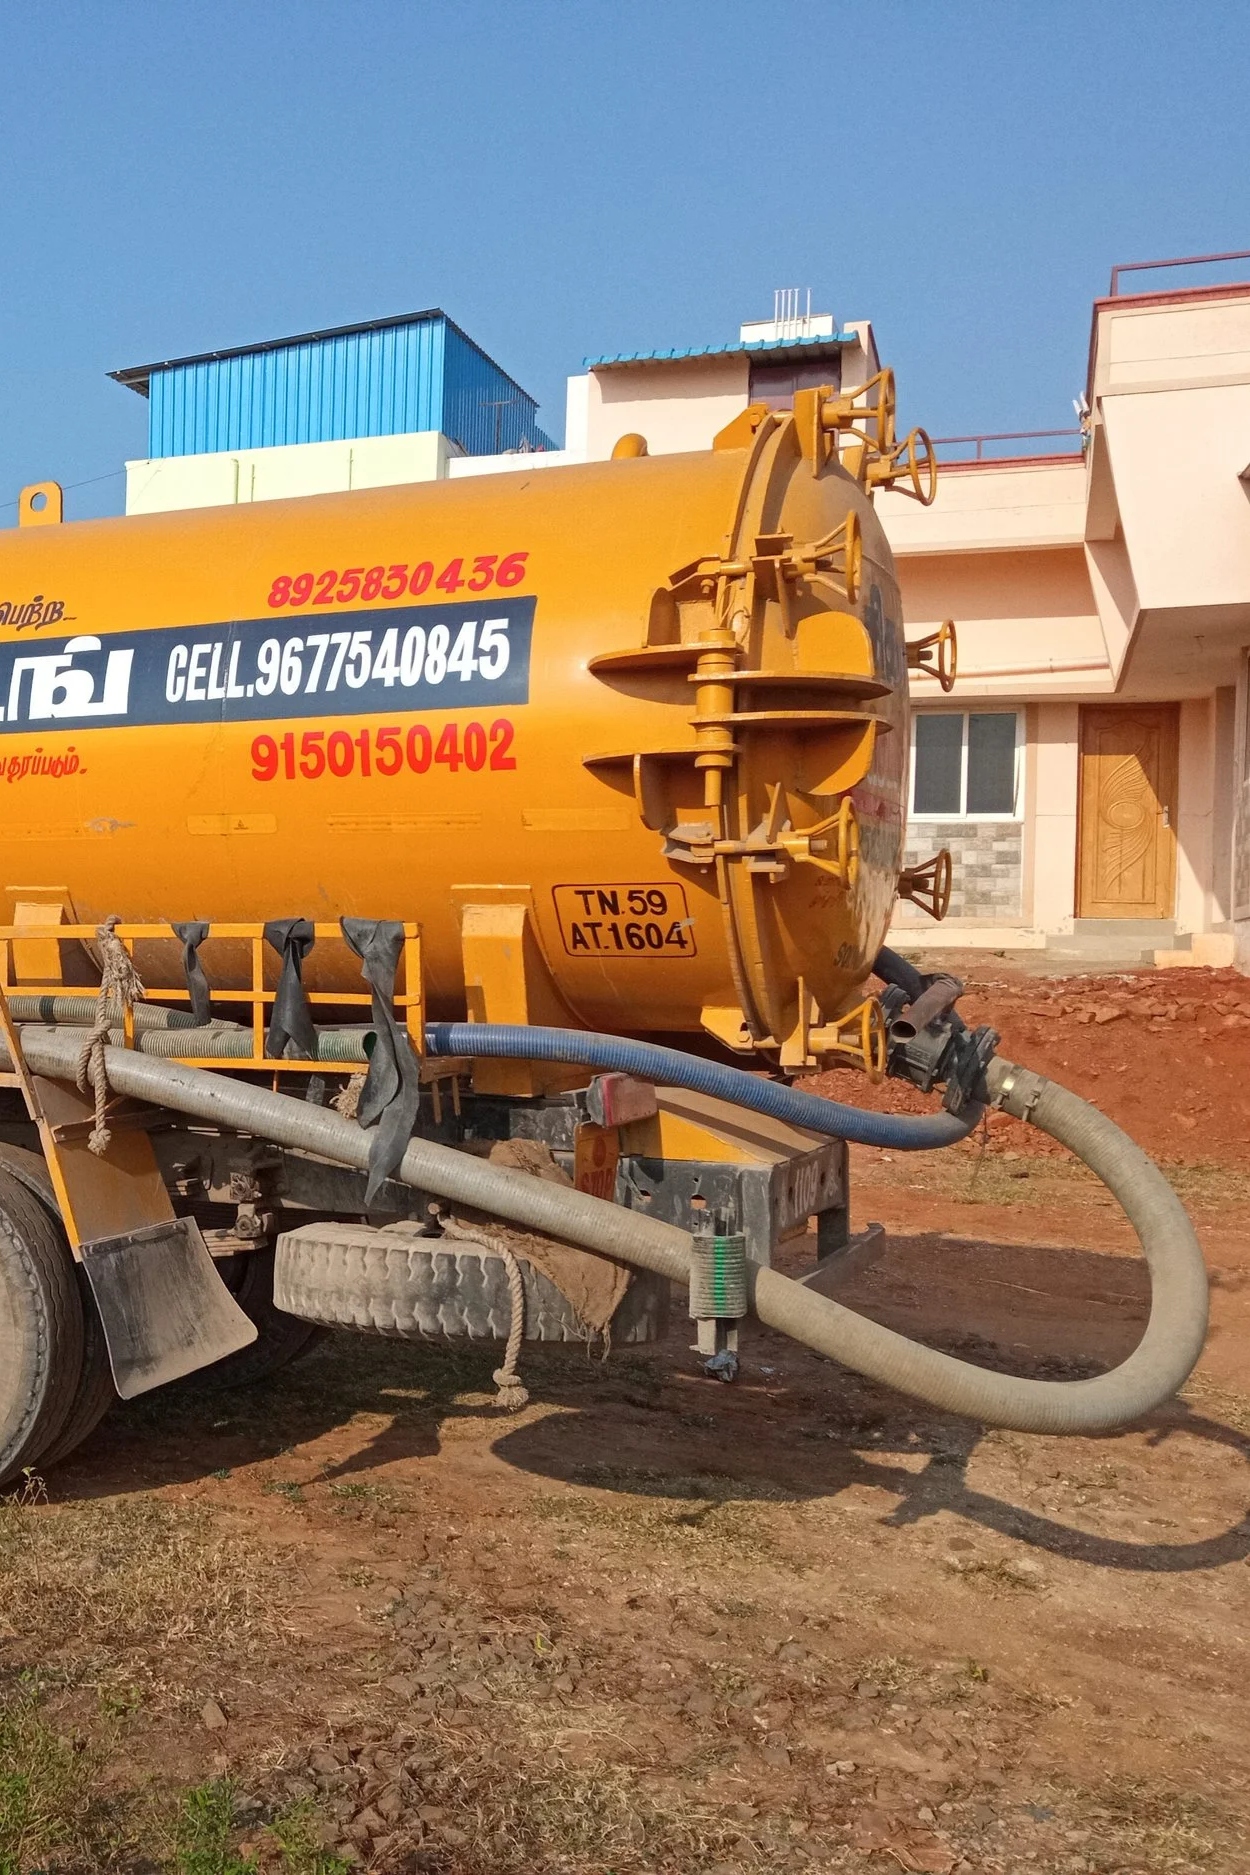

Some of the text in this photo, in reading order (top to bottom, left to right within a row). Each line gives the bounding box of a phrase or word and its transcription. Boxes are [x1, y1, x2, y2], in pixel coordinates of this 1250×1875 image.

[267, 552, 530, 609] 8925830436
[251, 718, 518, 782] 9150150402
[574, 889, 668, 917] TN.59
[571, 921, 689, 951] AT.1604
